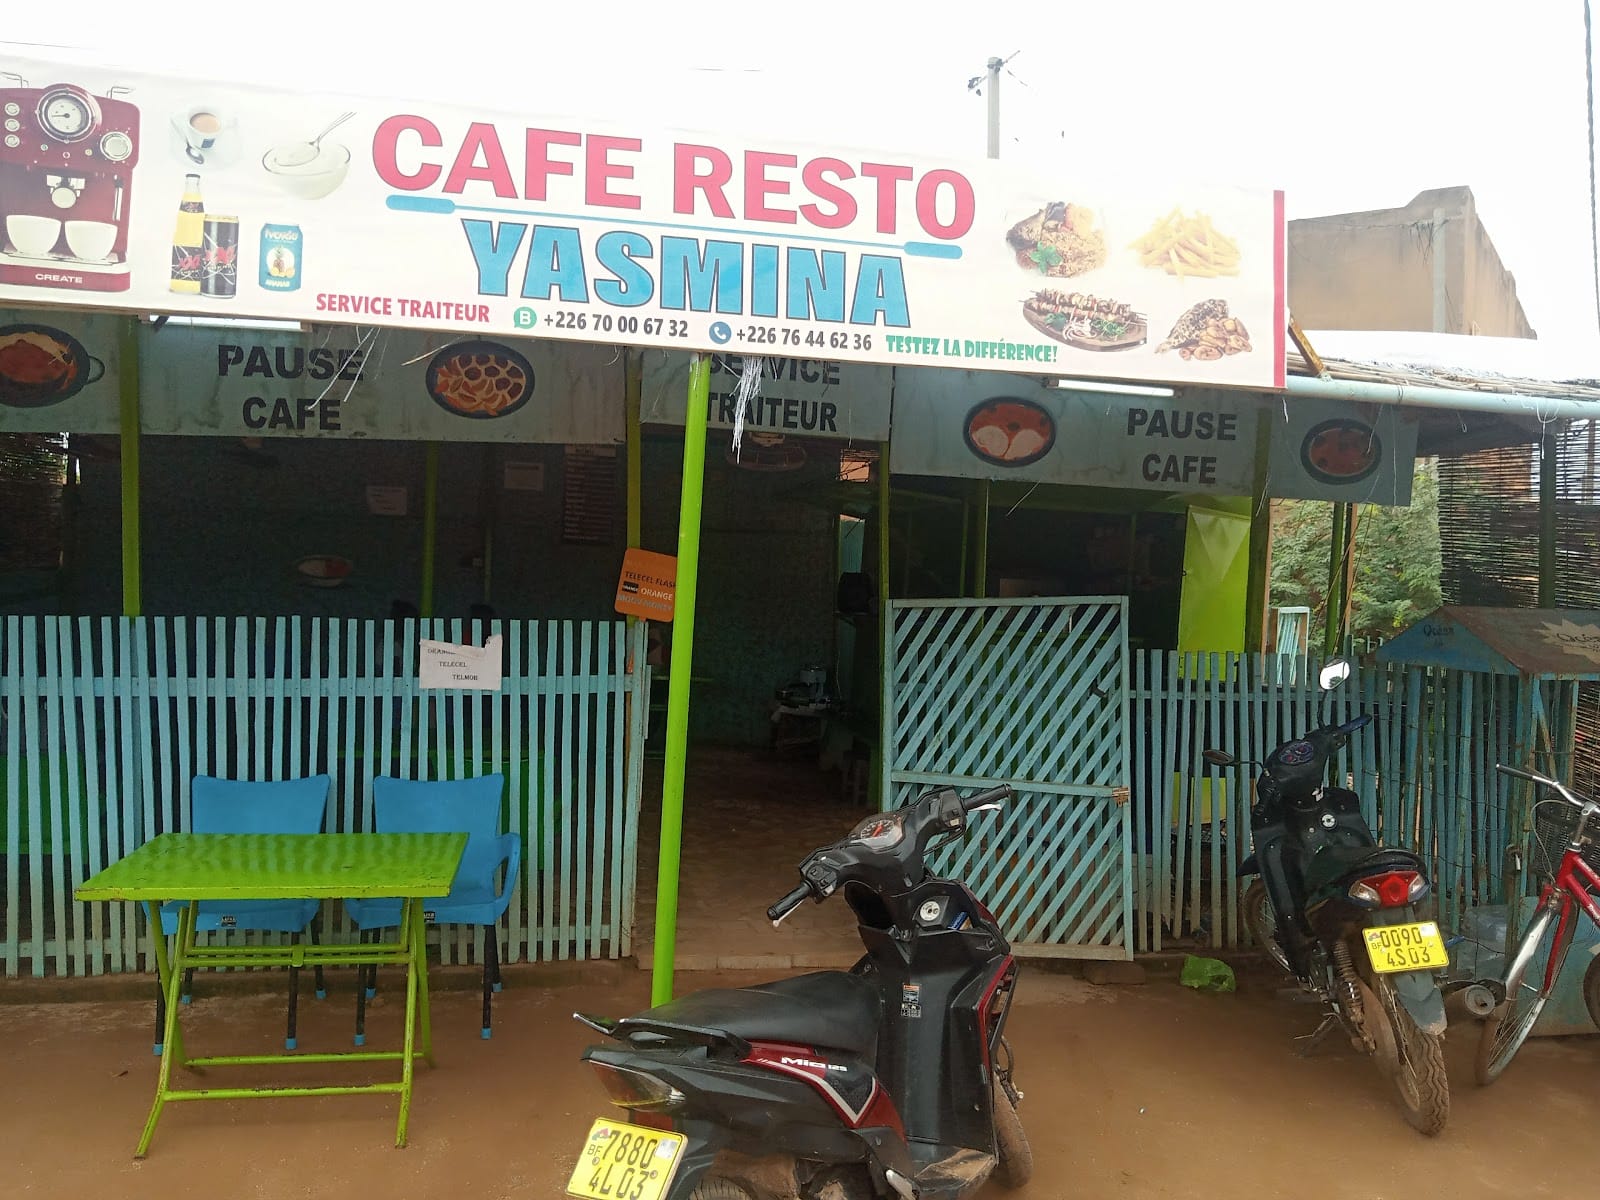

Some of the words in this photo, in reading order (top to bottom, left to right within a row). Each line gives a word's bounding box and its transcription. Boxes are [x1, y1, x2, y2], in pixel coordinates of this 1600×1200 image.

[372, 114, 642, 210] CAFE
[673, 142, 976, 241] RESTO
[35, 273, 83, 284] CREATE
[460, 218, 911, 328] YASMINA
[316, 293, 392, 315] SERVICE
[398, 298, 490, 323] TRAITEUR
[544, 311, 587, 330] +226
[592, 313, 613, 332] 70
[617, 315, 638, 334] 00
[643, 317, 664, 336] 67
[668, 319, 688, 338] 32
[736, 325, 777, 344] +226
[781, 328, 800, 346] 76
[804, 330, 825, 348] 44
[829, 332, 848, 350] 62
[853, 333, 872, 351] 36
[218, 344, 364, 381] PAUSE
[885, 334, 940, 356] TESTEZ
[943, 338, 961, 357] LA
[964, 338, 1058, 363] DIFFÉRENCE!
[710, 354, 841, 385] SEVICE
[242, 397, 341, 430] CAFE
[1127, 407, 1237, 441] PAUSE
[1142, 453, 1217, 484] CAFE
[640, 587, 673, 601] ORANGE
[1380, 927, 1422, 948] 0090
[1387, 946, 1430, 967] 4S03
[781, 1057, 826, 1069] Mio
[587, 1144, 603, 1156] BF
[602, 1130, 658, 1169] 7880
[588, 1163, 650, 1200] 4L03
